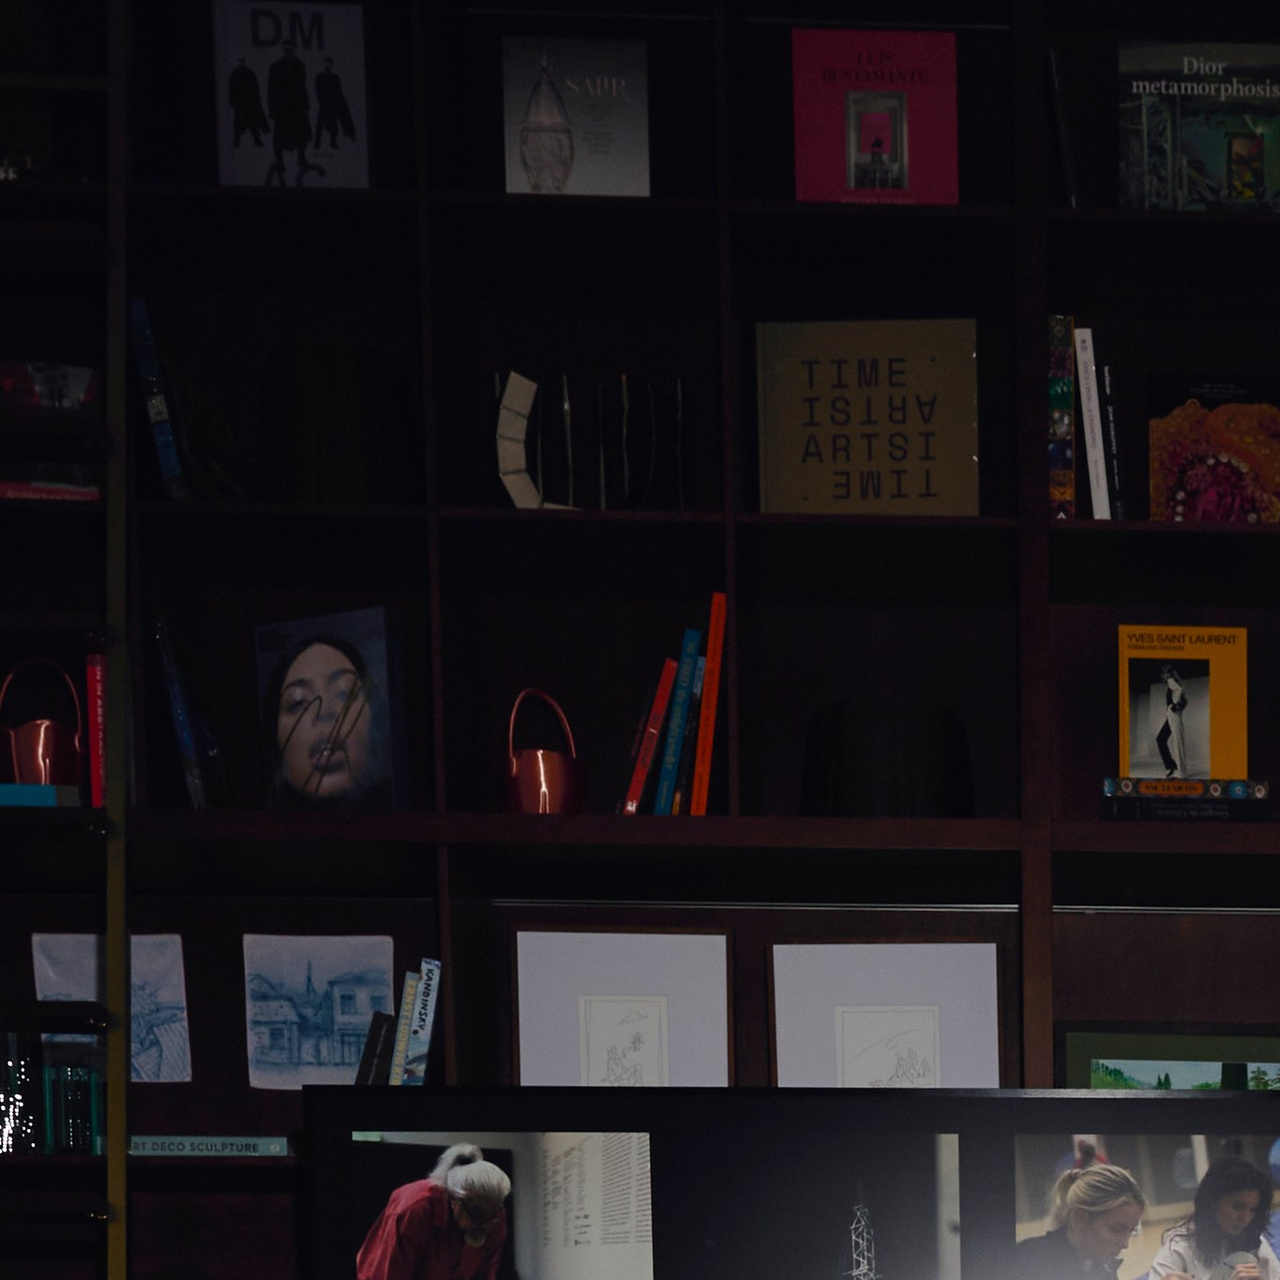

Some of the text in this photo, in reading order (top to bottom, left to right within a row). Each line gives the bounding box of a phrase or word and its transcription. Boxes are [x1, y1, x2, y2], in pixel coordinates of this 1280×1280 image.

[1182, 56, 1227, 75] Dior
[1131, 77, 1280, 101] metamorphosis
[801, 357, 907, 389] TIME
[1127, 633, 1238, 645] YVES SAINT LAURENT
[418, 967, 434, 1031] KANDINSKY
[151, 1141, 185, 1152] DECO
[189, 1141, 260, 1153] SCULPTURE
